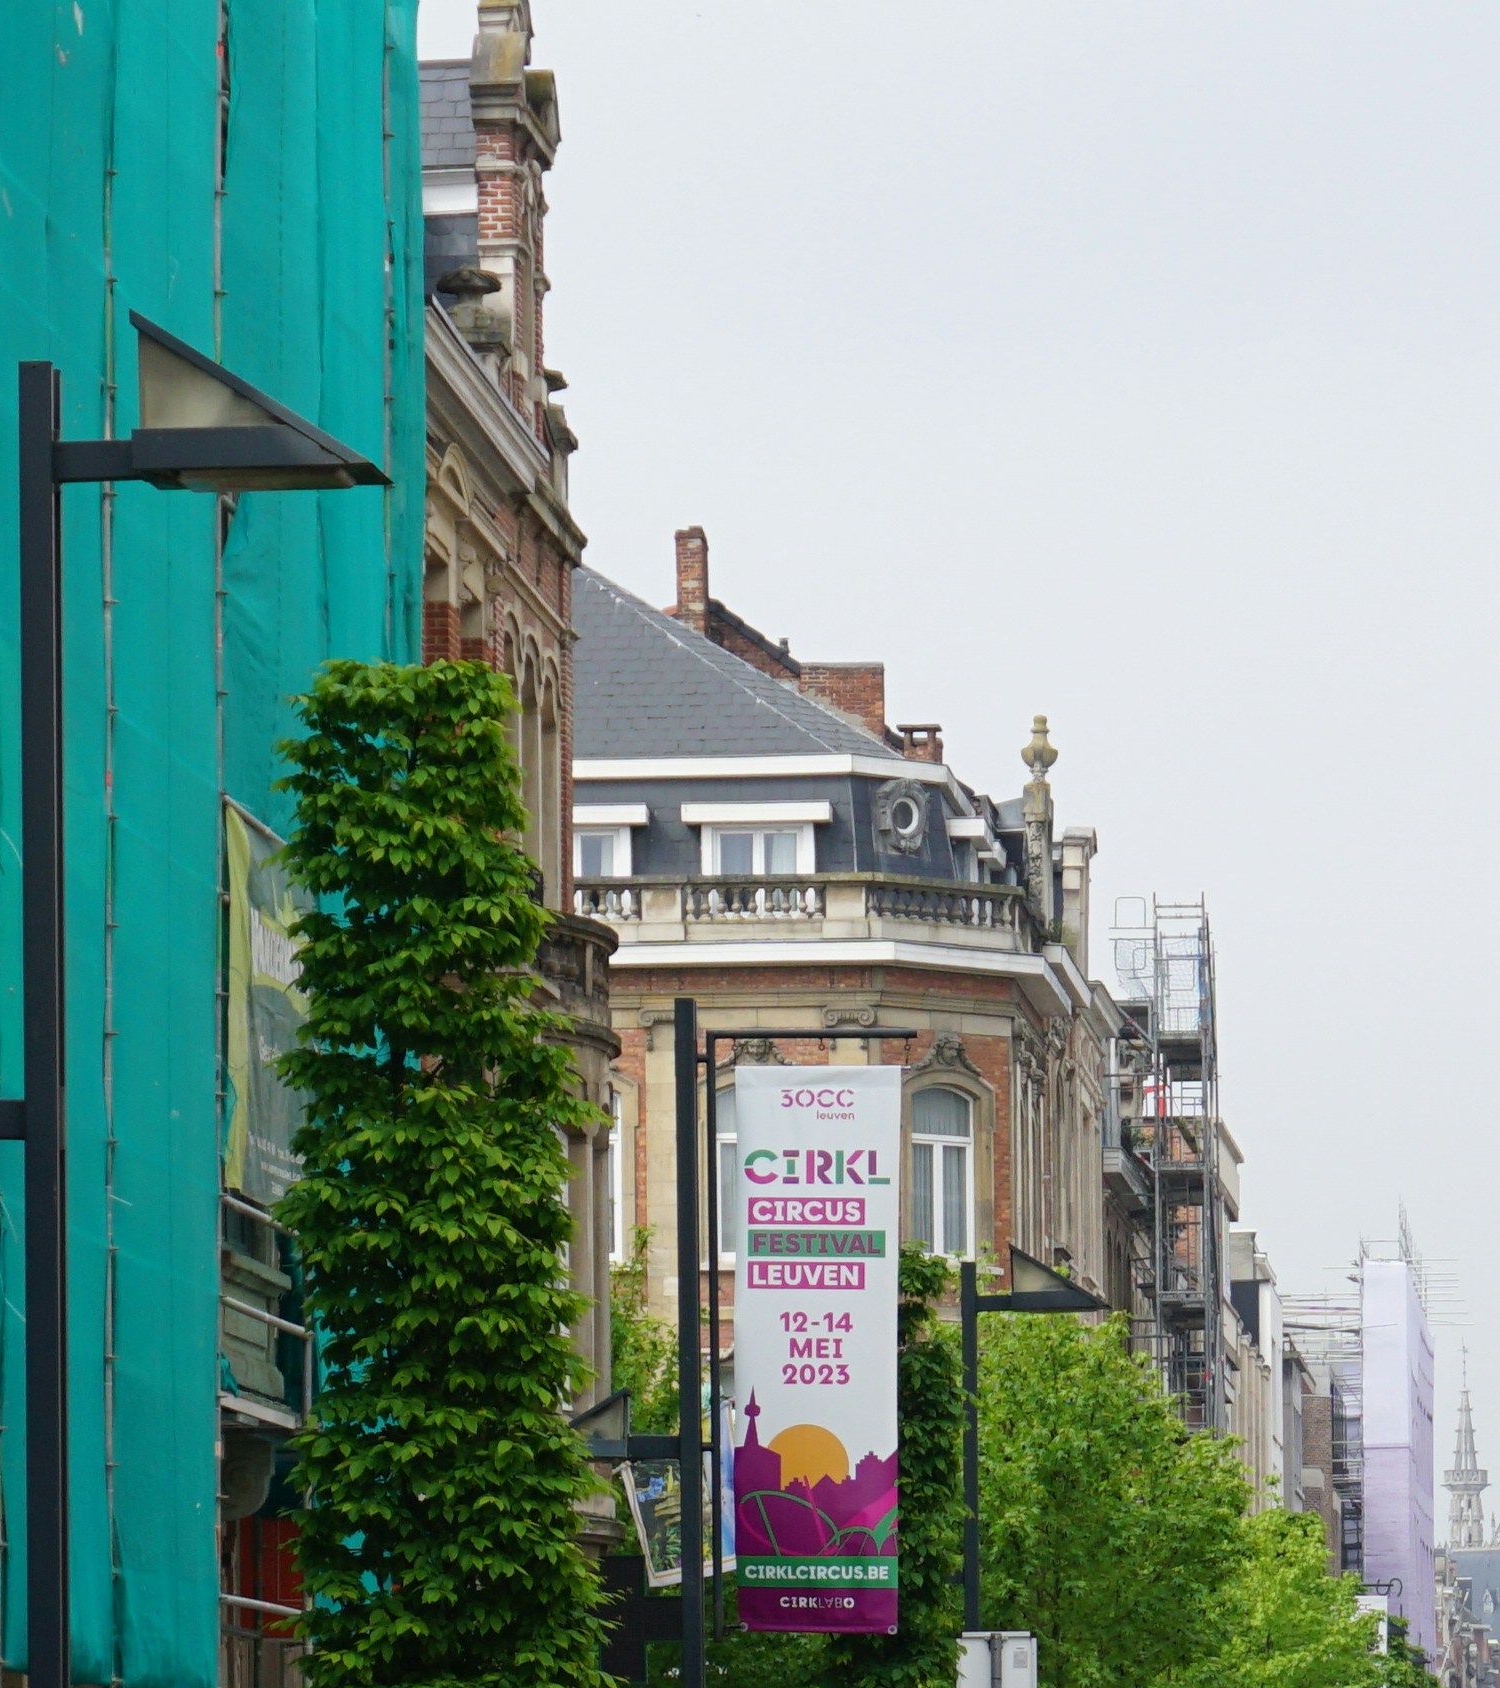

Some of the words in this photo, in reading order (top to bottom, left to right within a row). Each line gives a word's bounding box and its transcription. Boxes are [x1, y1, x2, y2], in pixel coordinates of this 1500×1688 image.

[780, 1088, 855, 1108] 30CC
[816, 1109, 856, 1121] leuven
[743, 1149, 891, 1185] CIRKL
[752, 1200, 862, 1222] CIRCUS
[753, 1233, 881, 1255] FESTIVAL
[752, 1264, 859, 1286] LEUVEN
[779, 1311, 854, 1333] 12-14
[788, 1337, 843, 1359] MEI
[781, 1363, 851, 1386] 2023
[744, 1565, 890, 1580] CIRKLCIRCUS.BE
